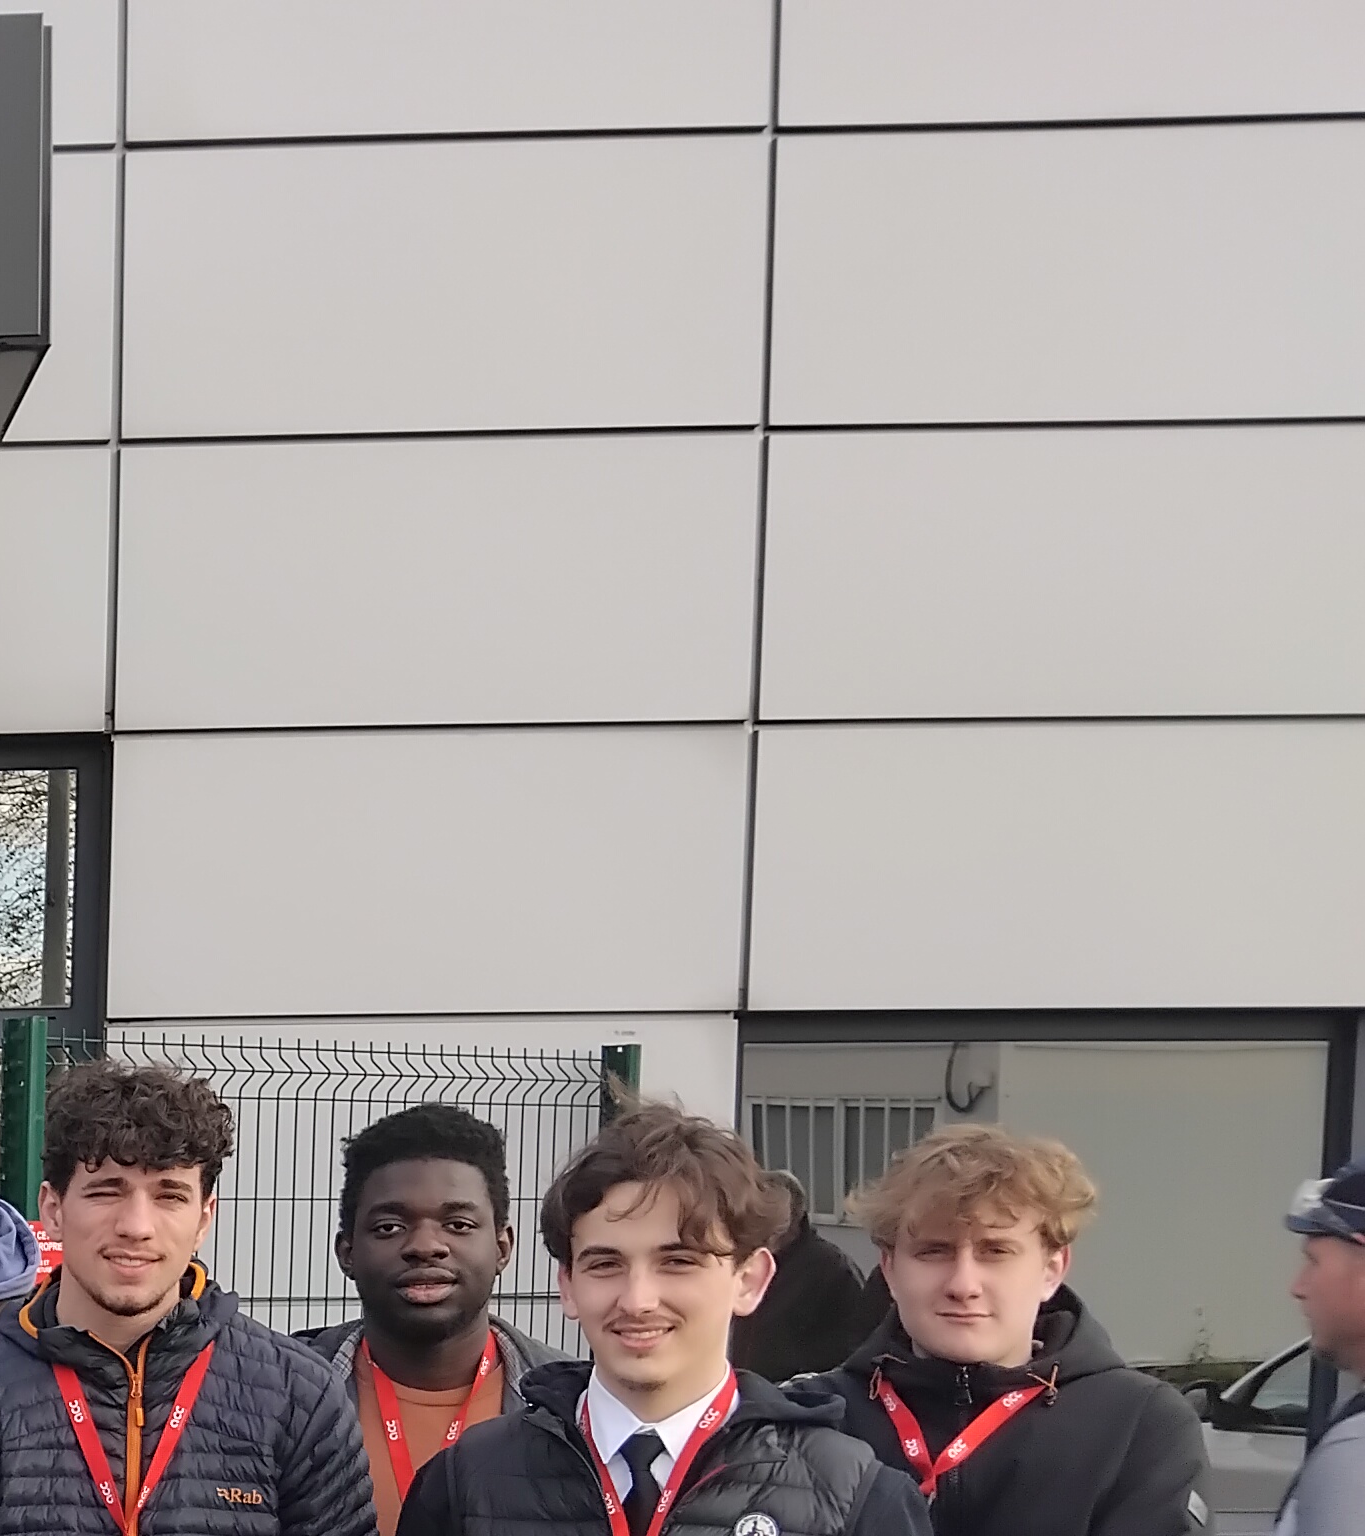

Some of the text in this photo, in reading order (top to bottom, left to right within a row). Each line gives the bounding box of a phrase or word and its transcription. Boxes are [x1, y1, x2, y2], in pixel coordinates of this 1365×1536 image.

[69, 1400, 83, 1423] acc
[170, 1406, 184, 1428] acc
[699, 1408, 719, 1429] acc
[386, 1420, 398, 1440] acc
[447, 1421, 459, 1440] acc
[948, 1438, 967, 1459] acc
[100, 1481, 113, 1504] acc
[229, 1488, 263, 1505] Rab
[658, 1490, 671, 1513] acc
